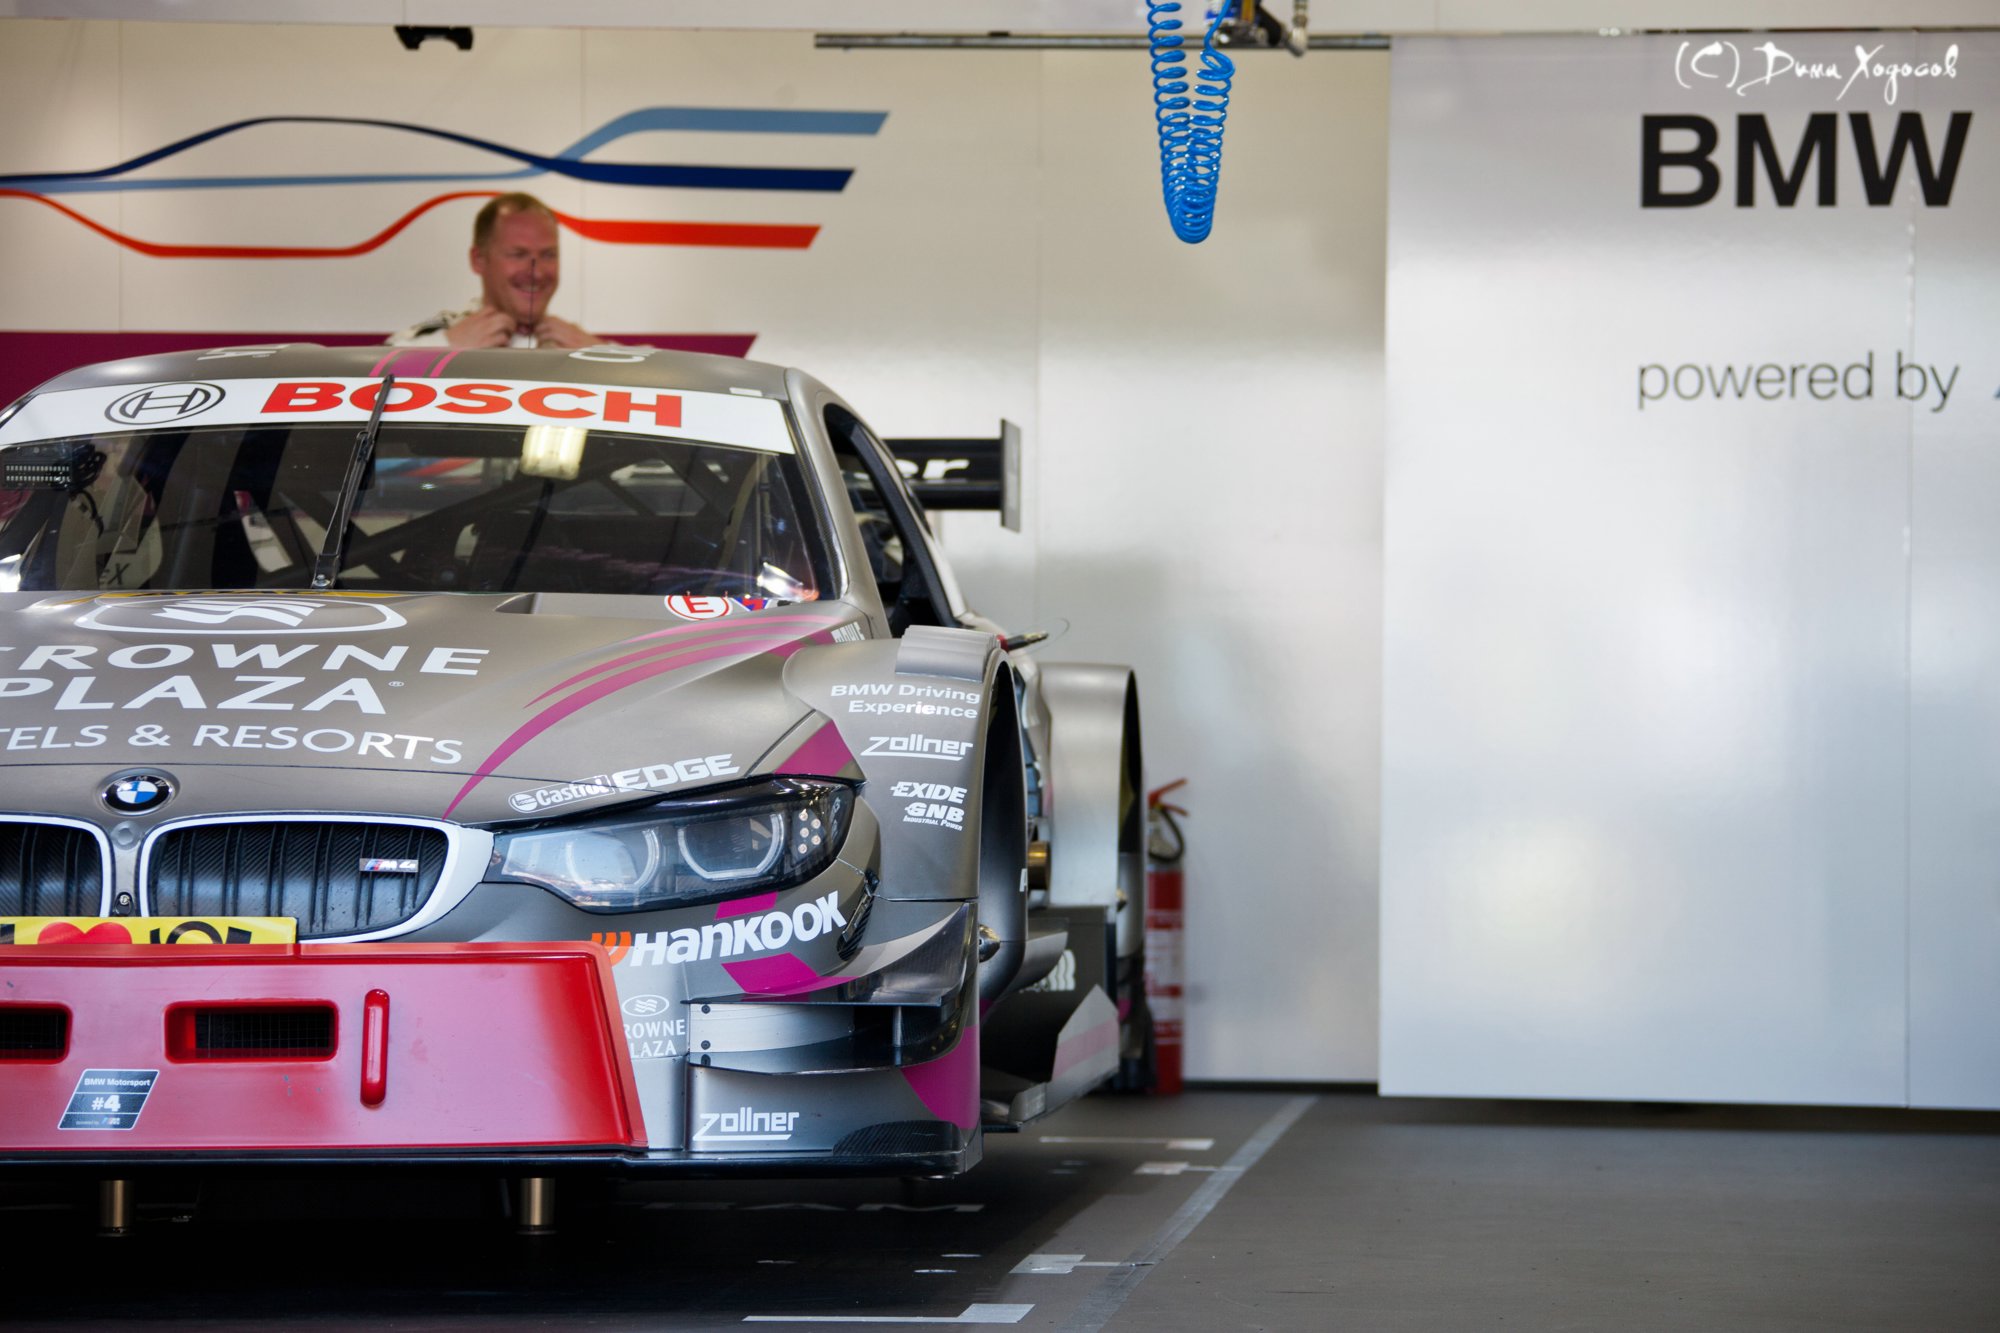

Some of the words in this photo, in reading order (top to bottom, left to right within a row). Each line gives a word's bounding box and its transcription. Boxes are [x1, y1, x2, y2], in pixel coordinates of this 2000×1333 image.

[1639, 110, 1973, 208] BMW
[1638, 350, 1874, 411] powered
[1896, 350, 1960, 412] by
[260, 382, 683, 428] BOSCH
[0, 644, 490, 675] ROWNE
[831, 684, 894, 697] BMW
[899, 684, 981, 705] Driving
[848, 700, 978, 719] Experience
[0, 725, 108, 751] ELS
[128, 724, 171, 747] &
[193, 726, 463, 765] RESORTS
[612, 753, 740, 793] EDGE
[890, 781, 968, 804] EXIDE
[904, 802, 965, 823] GNB
[623, 1019, 686, 1039] ROWNE
[630, 1039, 677, 1058] LAZA
[84, 1078, 105, 1086] BMW
[107, 1078, 151, 1088] Motorsport
[91, 1094, 121, 1112] #4
